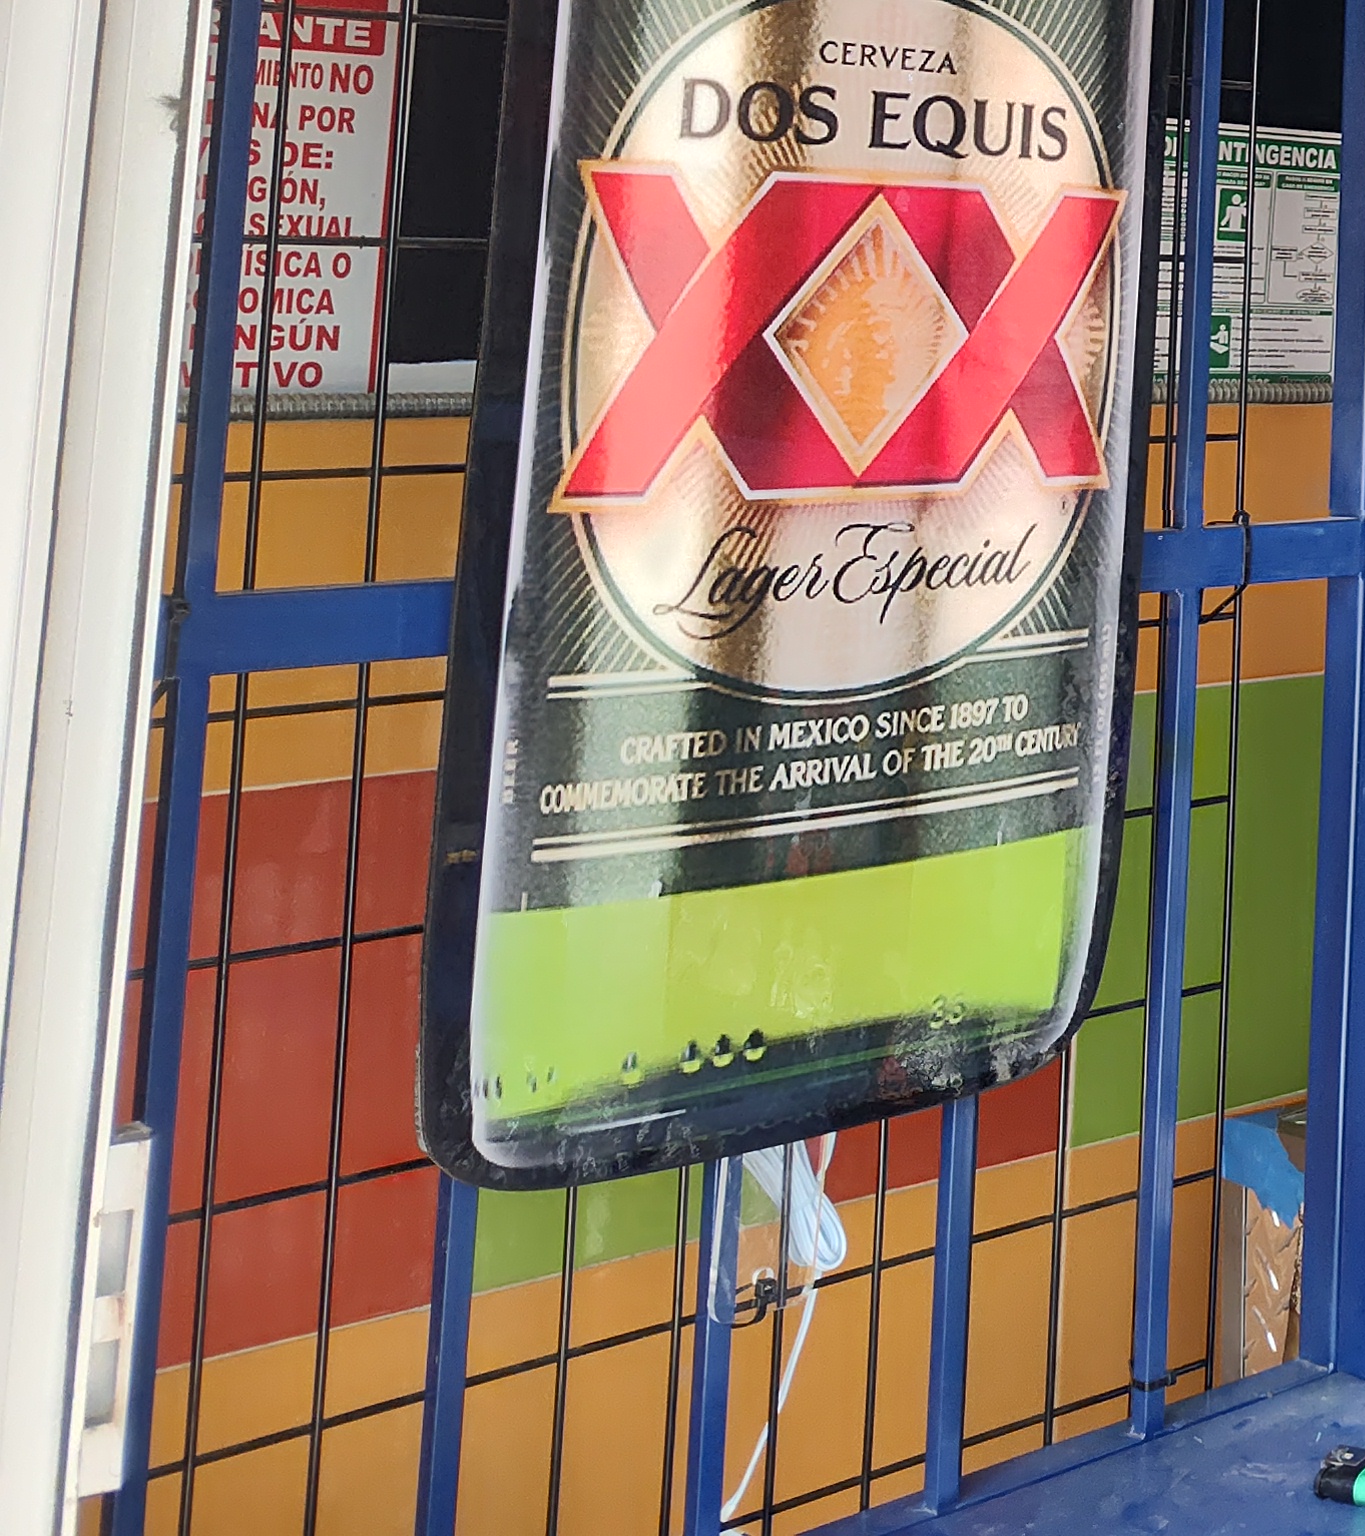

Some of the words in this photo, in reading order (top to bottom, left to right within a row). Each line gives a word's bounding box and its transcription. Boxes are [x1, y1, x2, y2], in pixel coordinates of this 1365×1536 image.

[329, 65, 375, 95] NO
[818, 40, 958, 76] CERVEZA
[299, 106, 356, 135] POR
[679, 76, 841, 145] DOS
[867, 89, 1069, 163] EQUIS
[331, 251, 352, 278] O
[653, 524, 829, 640] Lager
[834, 521, 1038, 624] Especial
[619, 729, 728, 767] CRAFTED
[734, 724, 762, 753] IN
[767, 714, 870, 750] MEXICO
[874, 705, 945, 740] SINCE
[949, 698, 999, 729] 1897
[1001, 693, 1029, 725] TO
[540, 772, 707, 816] COMMEMORATE
[715, 766, 765, 795] THE
[768, 755, 877, 792] ARRIVAL
[882, 745, 917, 776] OF
[920, 739, 967, 772] THE
[1013, 720, 1083, 760] CENTURY
